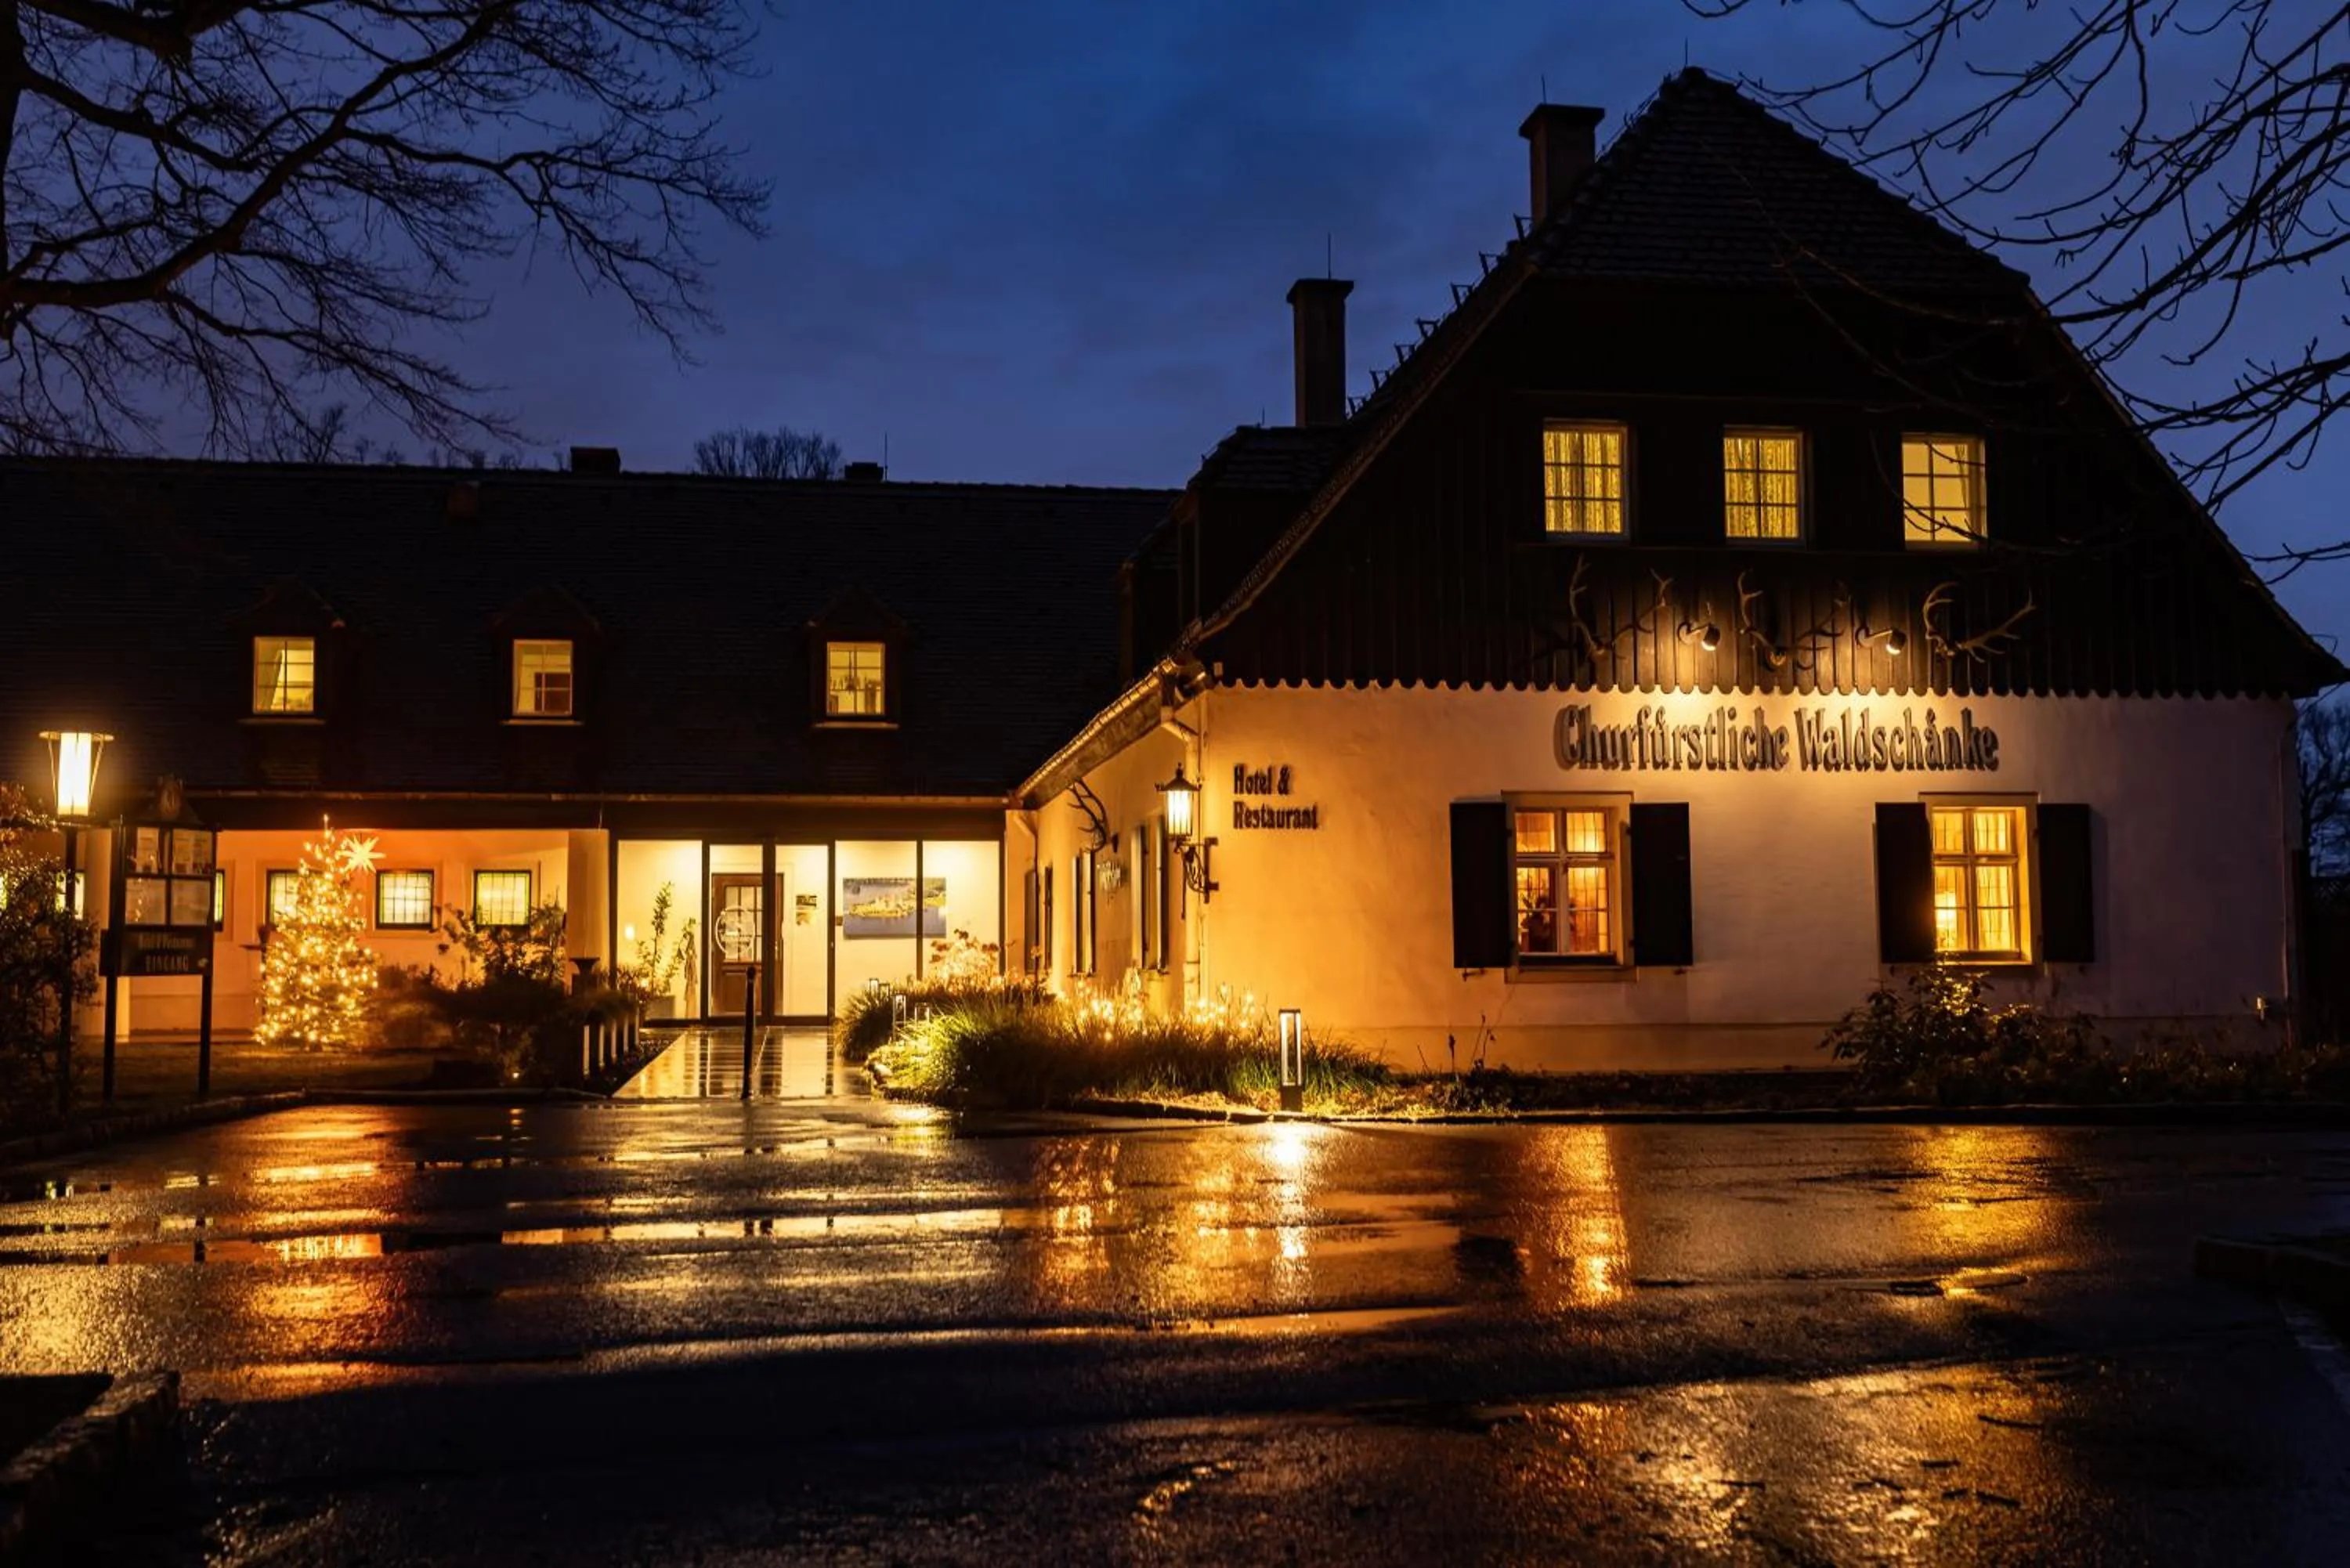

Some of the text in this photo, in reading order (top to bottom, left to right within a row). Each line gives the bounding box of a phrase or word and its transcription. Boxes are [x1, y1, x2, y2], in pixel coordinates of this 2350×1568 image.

[1234, 763, 1290, 795] Hotel &
[1233, 800, 1318, 829] Restaurant
